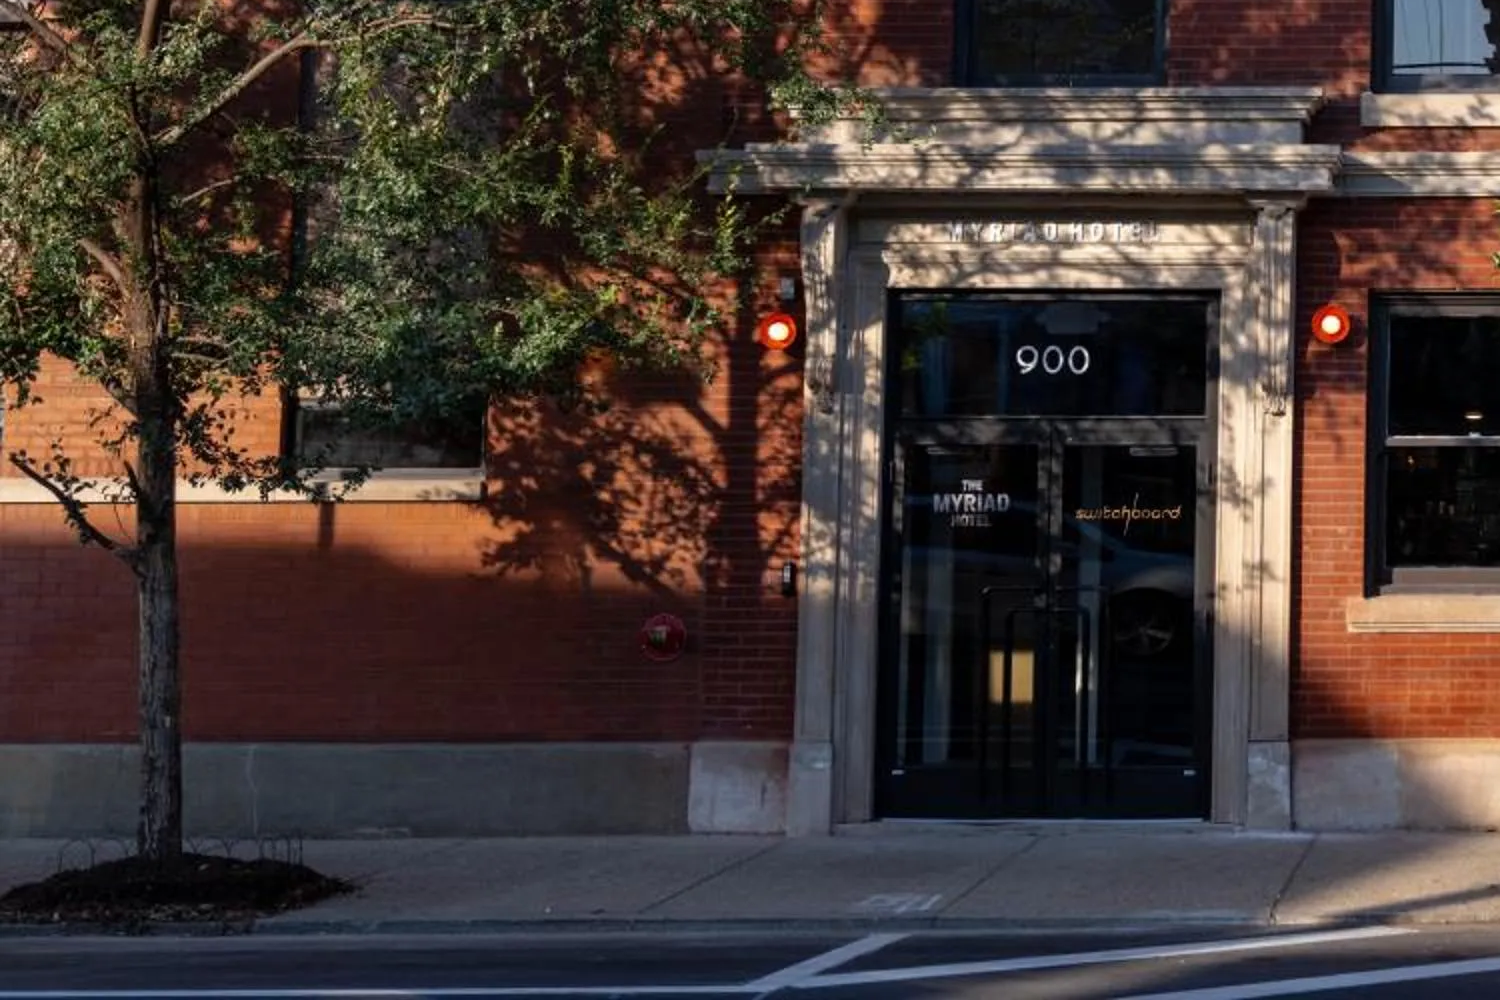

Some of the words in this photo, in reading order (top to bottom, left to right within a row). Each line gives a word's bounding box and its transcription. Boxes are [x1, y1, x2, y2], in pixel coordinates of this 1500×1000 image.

[1015, 344, 1090, 375] 900
[961, 479, 984, 492] THE
[933, 493, 1011, 513] MYRIAD
[950, 513, 993, 527] HOTEL
[1075, 492, 1182, 536] switchboard
